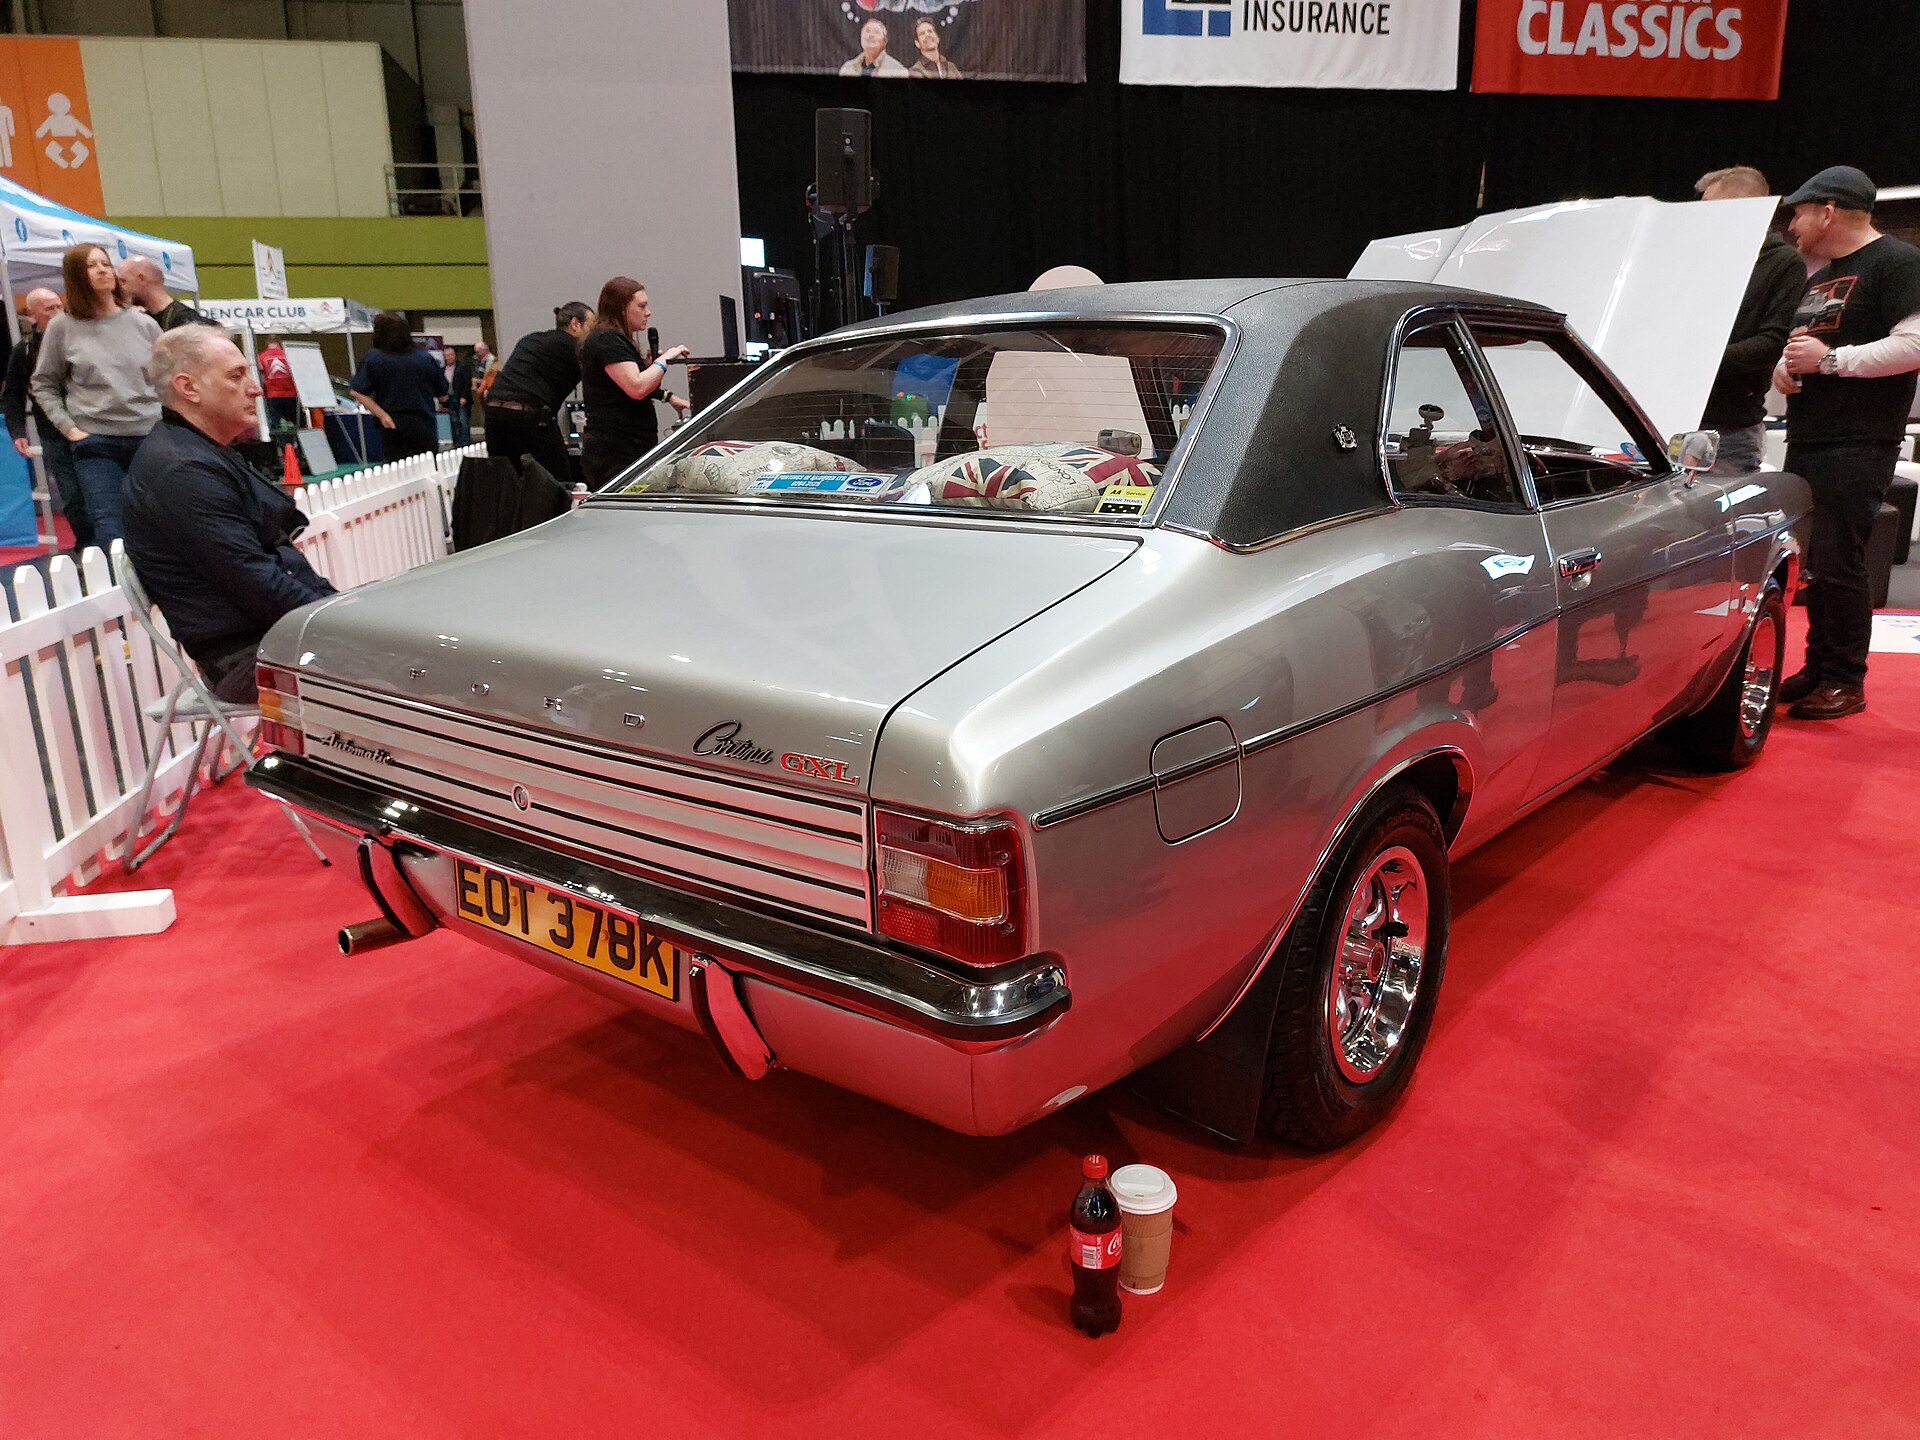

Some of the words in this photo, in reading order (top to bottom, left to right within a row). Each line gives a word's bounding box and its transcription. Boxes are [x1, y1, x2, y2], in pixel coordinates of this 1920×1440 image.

[1243, 0, 1390, 35] INSURANCE
[1517, 0, 1742, 60] CLASSICS
[234, 308, 264, 318] CAR
[267, 307, 306, 317] CLUB
[320, 731, 392, 765] Automatic
[692, 719, 774, 764] Cortina
[779, 751, 861, 785] GXL
[458, 859, 535, 935] EOT
[547, 890, 669, 987] 378K
